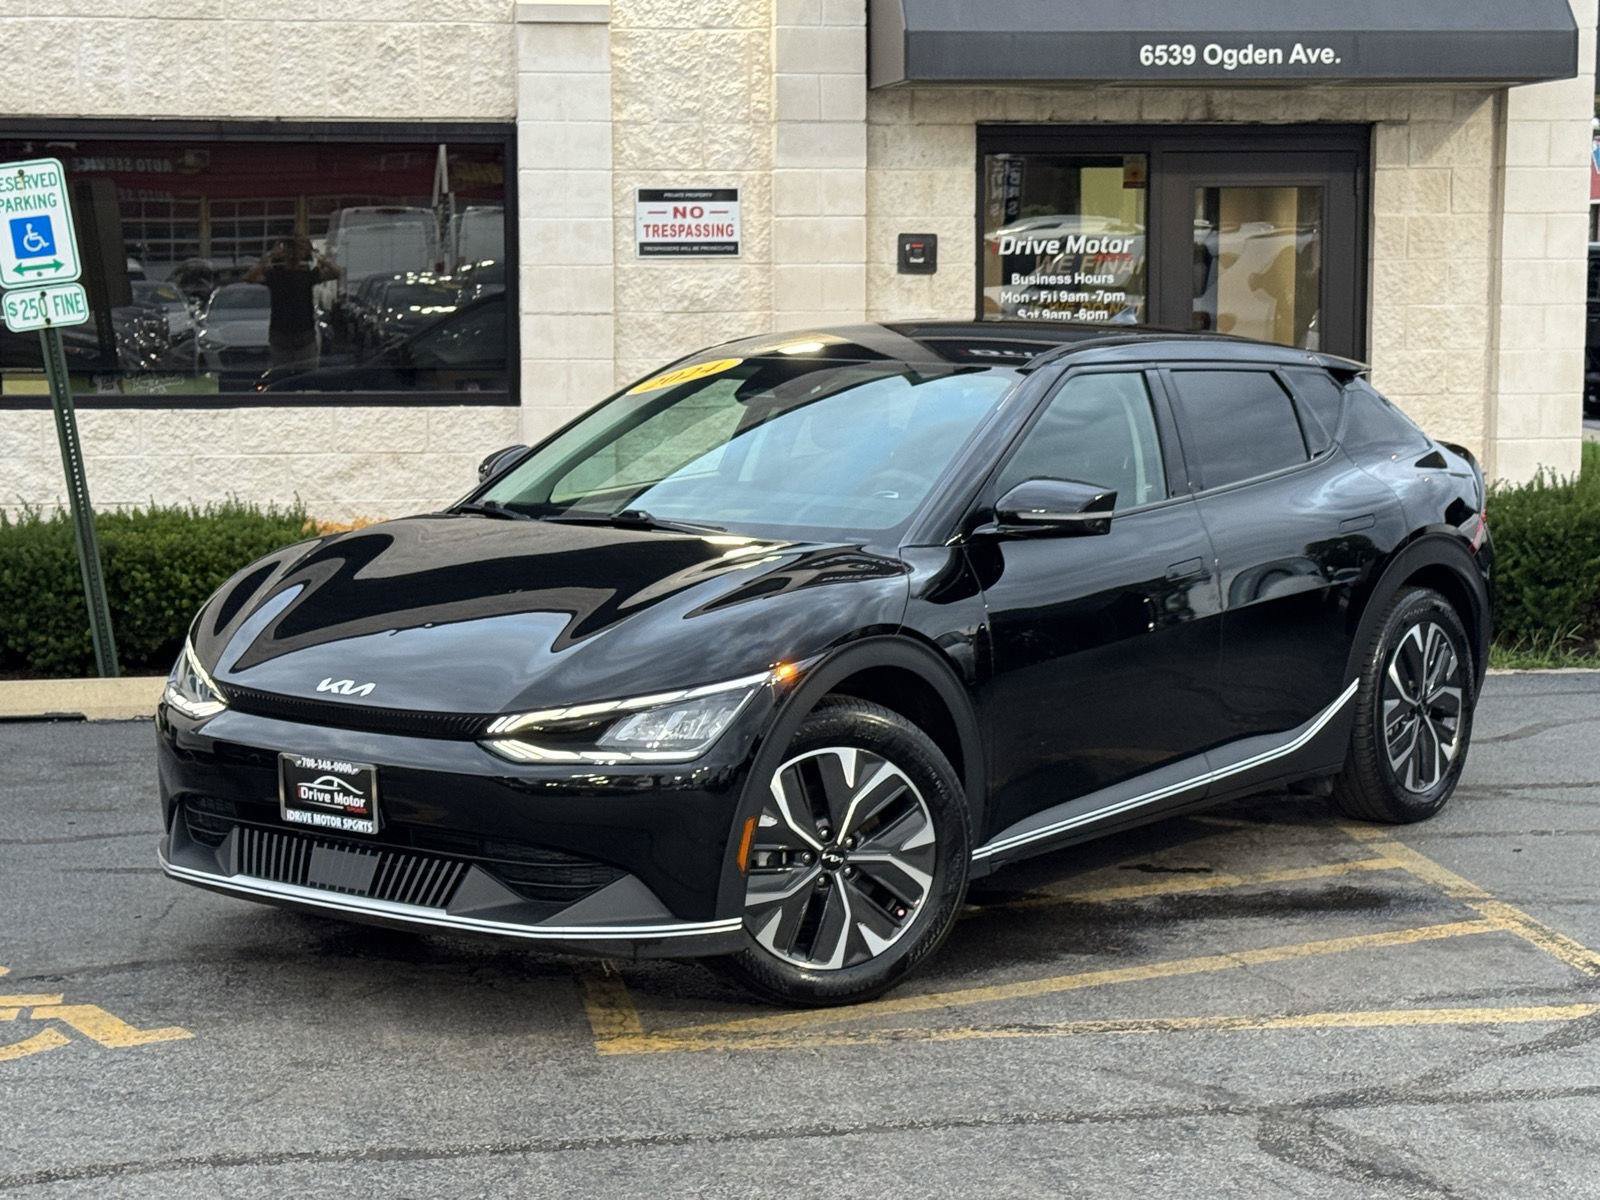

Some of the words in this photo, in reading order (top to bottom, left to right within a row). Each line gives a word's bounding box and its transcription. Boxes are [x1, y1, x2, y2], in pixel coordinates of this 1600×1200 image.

[1139, 44, 1197, 66] 6539
[1202, 43, 1283, 71] Ogden
[1288, 43, 1342, 65] Ave.
[0, 171, 58, 192] ESERVED
[673, 206, 704, 219] NO
[643, 223, 734, 238] TRESPASSING
[1065, 234, 1134, 254] Motor
[1011, 272, 1073, 286] Business
[1074, 272, 1114, 285] Hours
[53, 292, 85, 317] FINE
[1000, 291, 1030, 304] Mon
[333, 791, 366, 808] Motor
[313, 812, 342, 829] MOTOR
[342, 818, 373, 833] SPORTS
